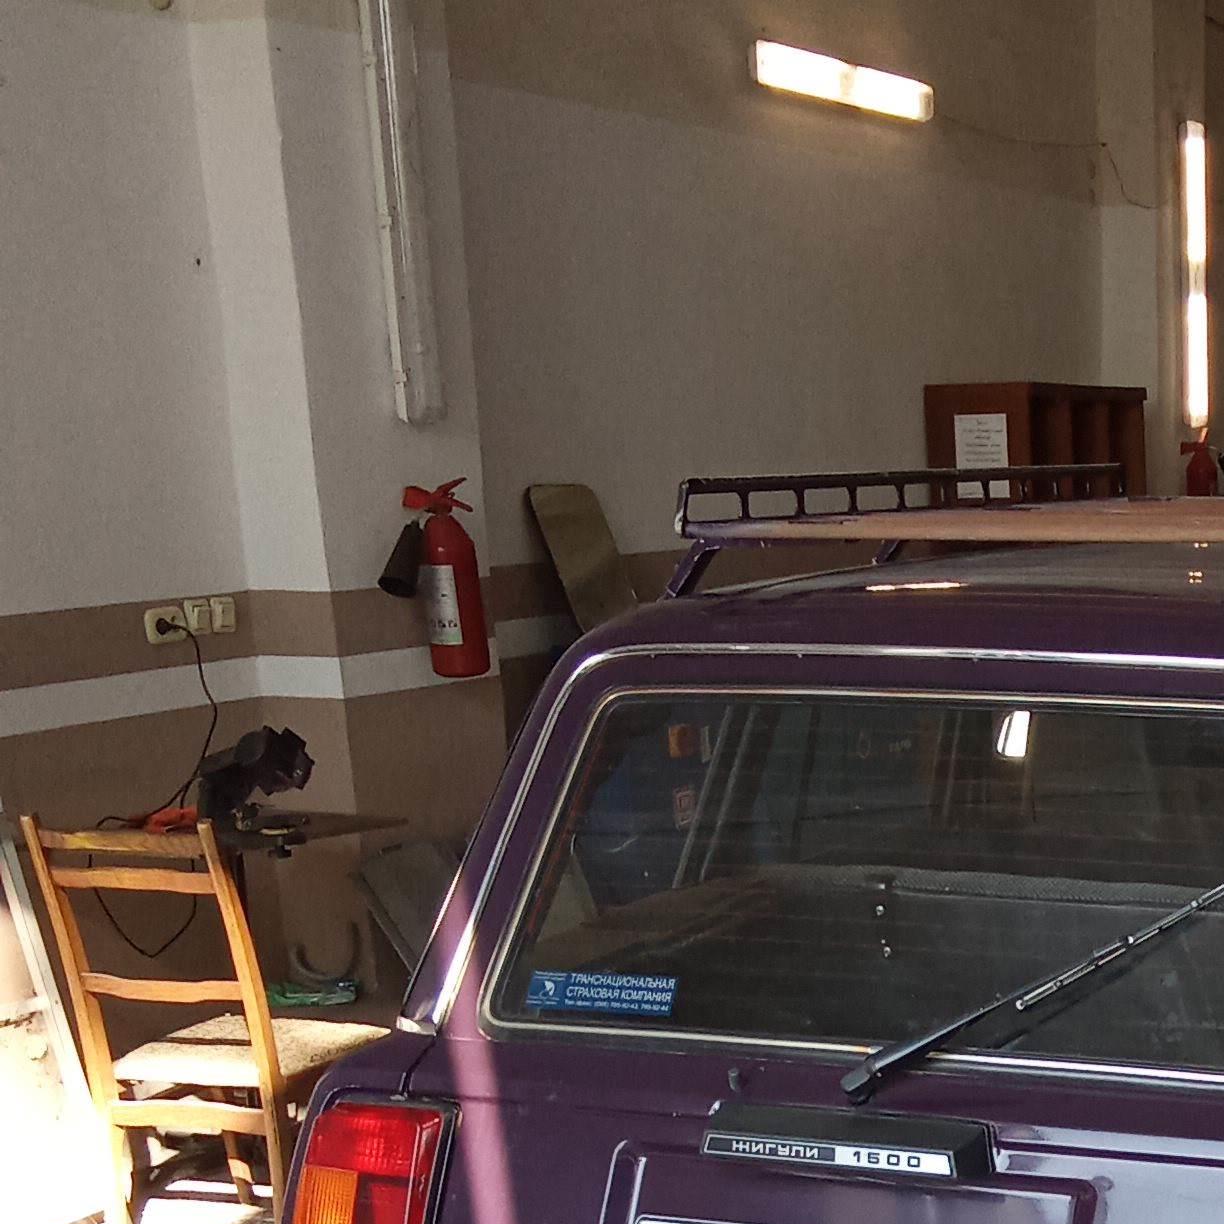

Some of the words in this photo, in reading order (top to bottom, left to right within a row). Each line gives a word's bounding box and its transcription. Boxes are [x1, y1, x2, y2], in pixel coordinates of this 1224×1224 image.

[571, 973, 676, 989] ТРАНСНАЦИОНАЛЬНАЯ
[566, 986, 620, 999] СТРАХОВАЯ
[621, 990, 672, 1003] КОМПАНИЯ
[732, 1139, 819, 1159] ЖИГУЛИ
[853, 1150, 921, 1168] 1500
